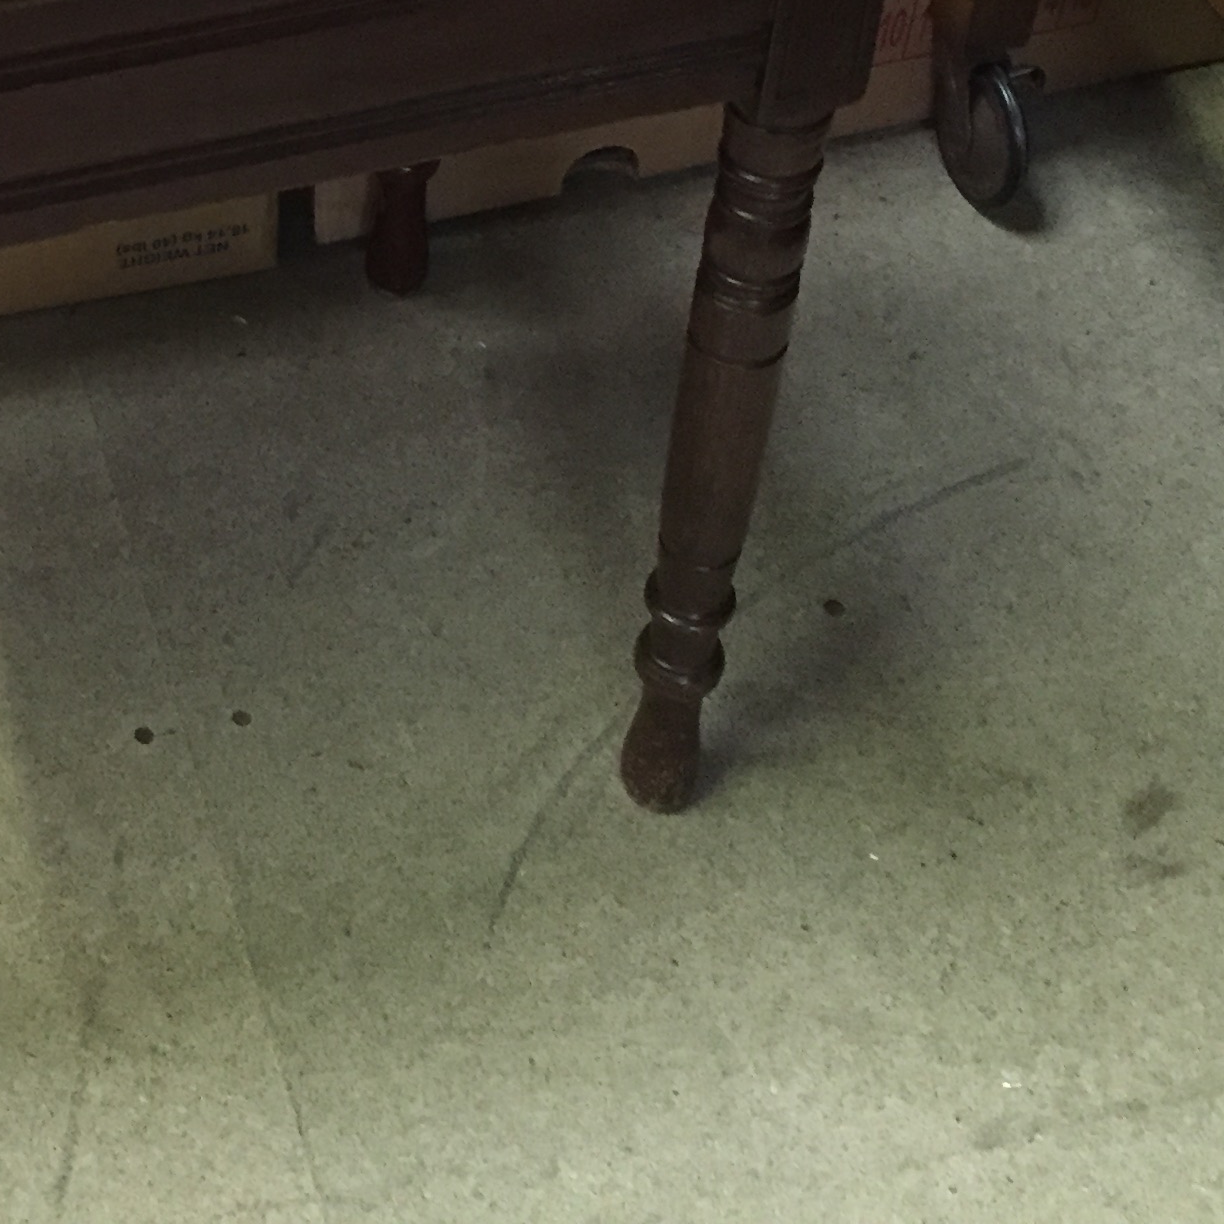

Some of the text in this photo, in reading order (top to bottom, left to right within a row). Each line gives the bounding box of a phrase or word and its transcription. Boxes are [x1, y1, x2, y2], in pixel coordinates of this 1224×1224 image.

[182, 232, 203, 243] kg
[116, 241, 147, 256] lbs)
[120, 241, 229, 269] NET WEIGHT
